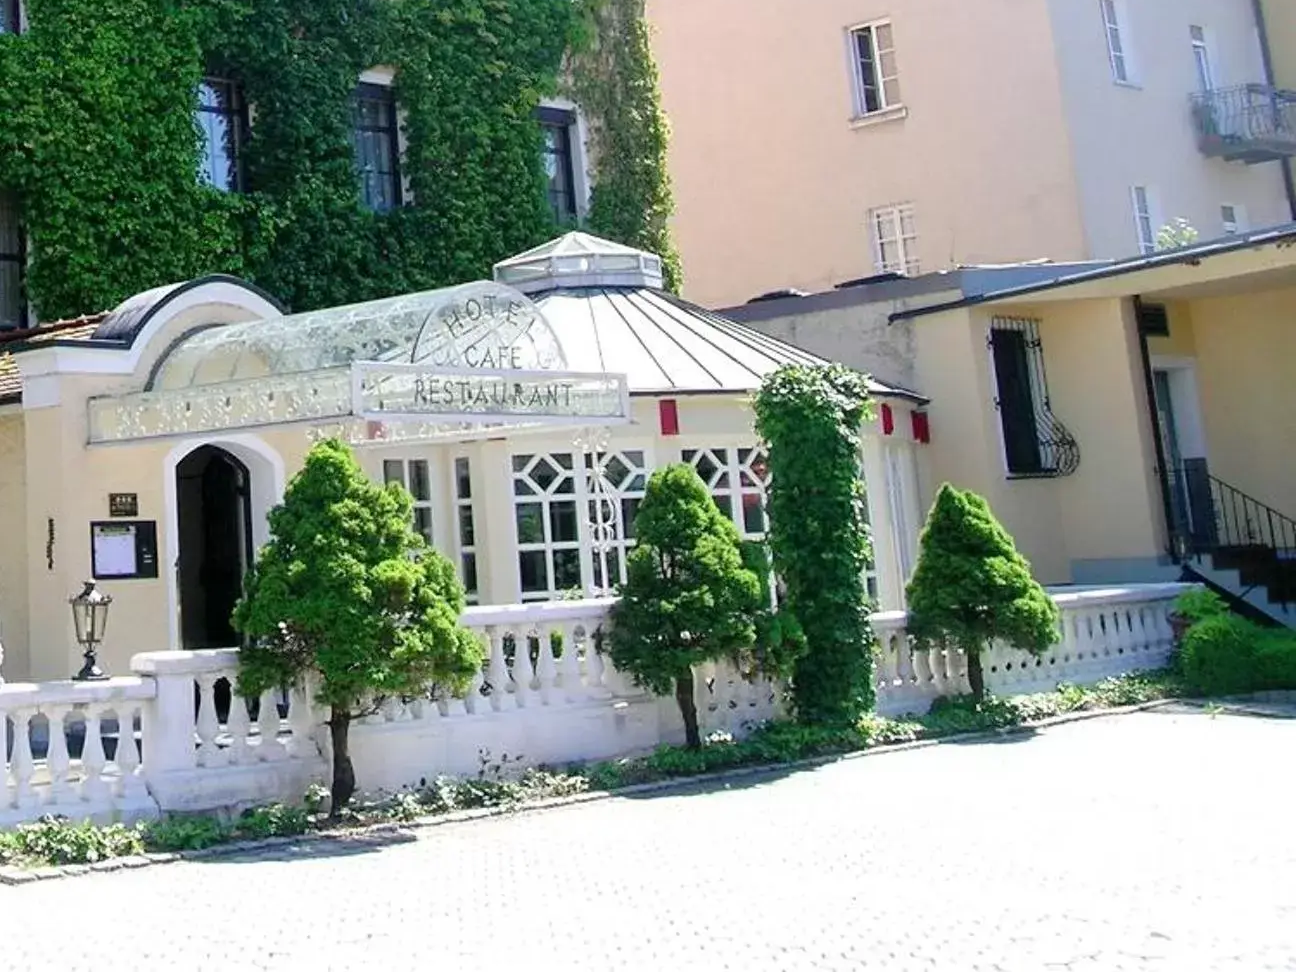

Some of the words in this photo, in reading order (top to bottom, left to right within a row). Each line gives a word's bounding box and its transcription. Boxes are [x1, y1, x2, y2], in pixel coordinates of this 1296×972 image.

[443, 295, 535, 344] HOTEL
[464, 346, 523, 370] CAFE
[414, 379, 573, 407] RESTAURANT
